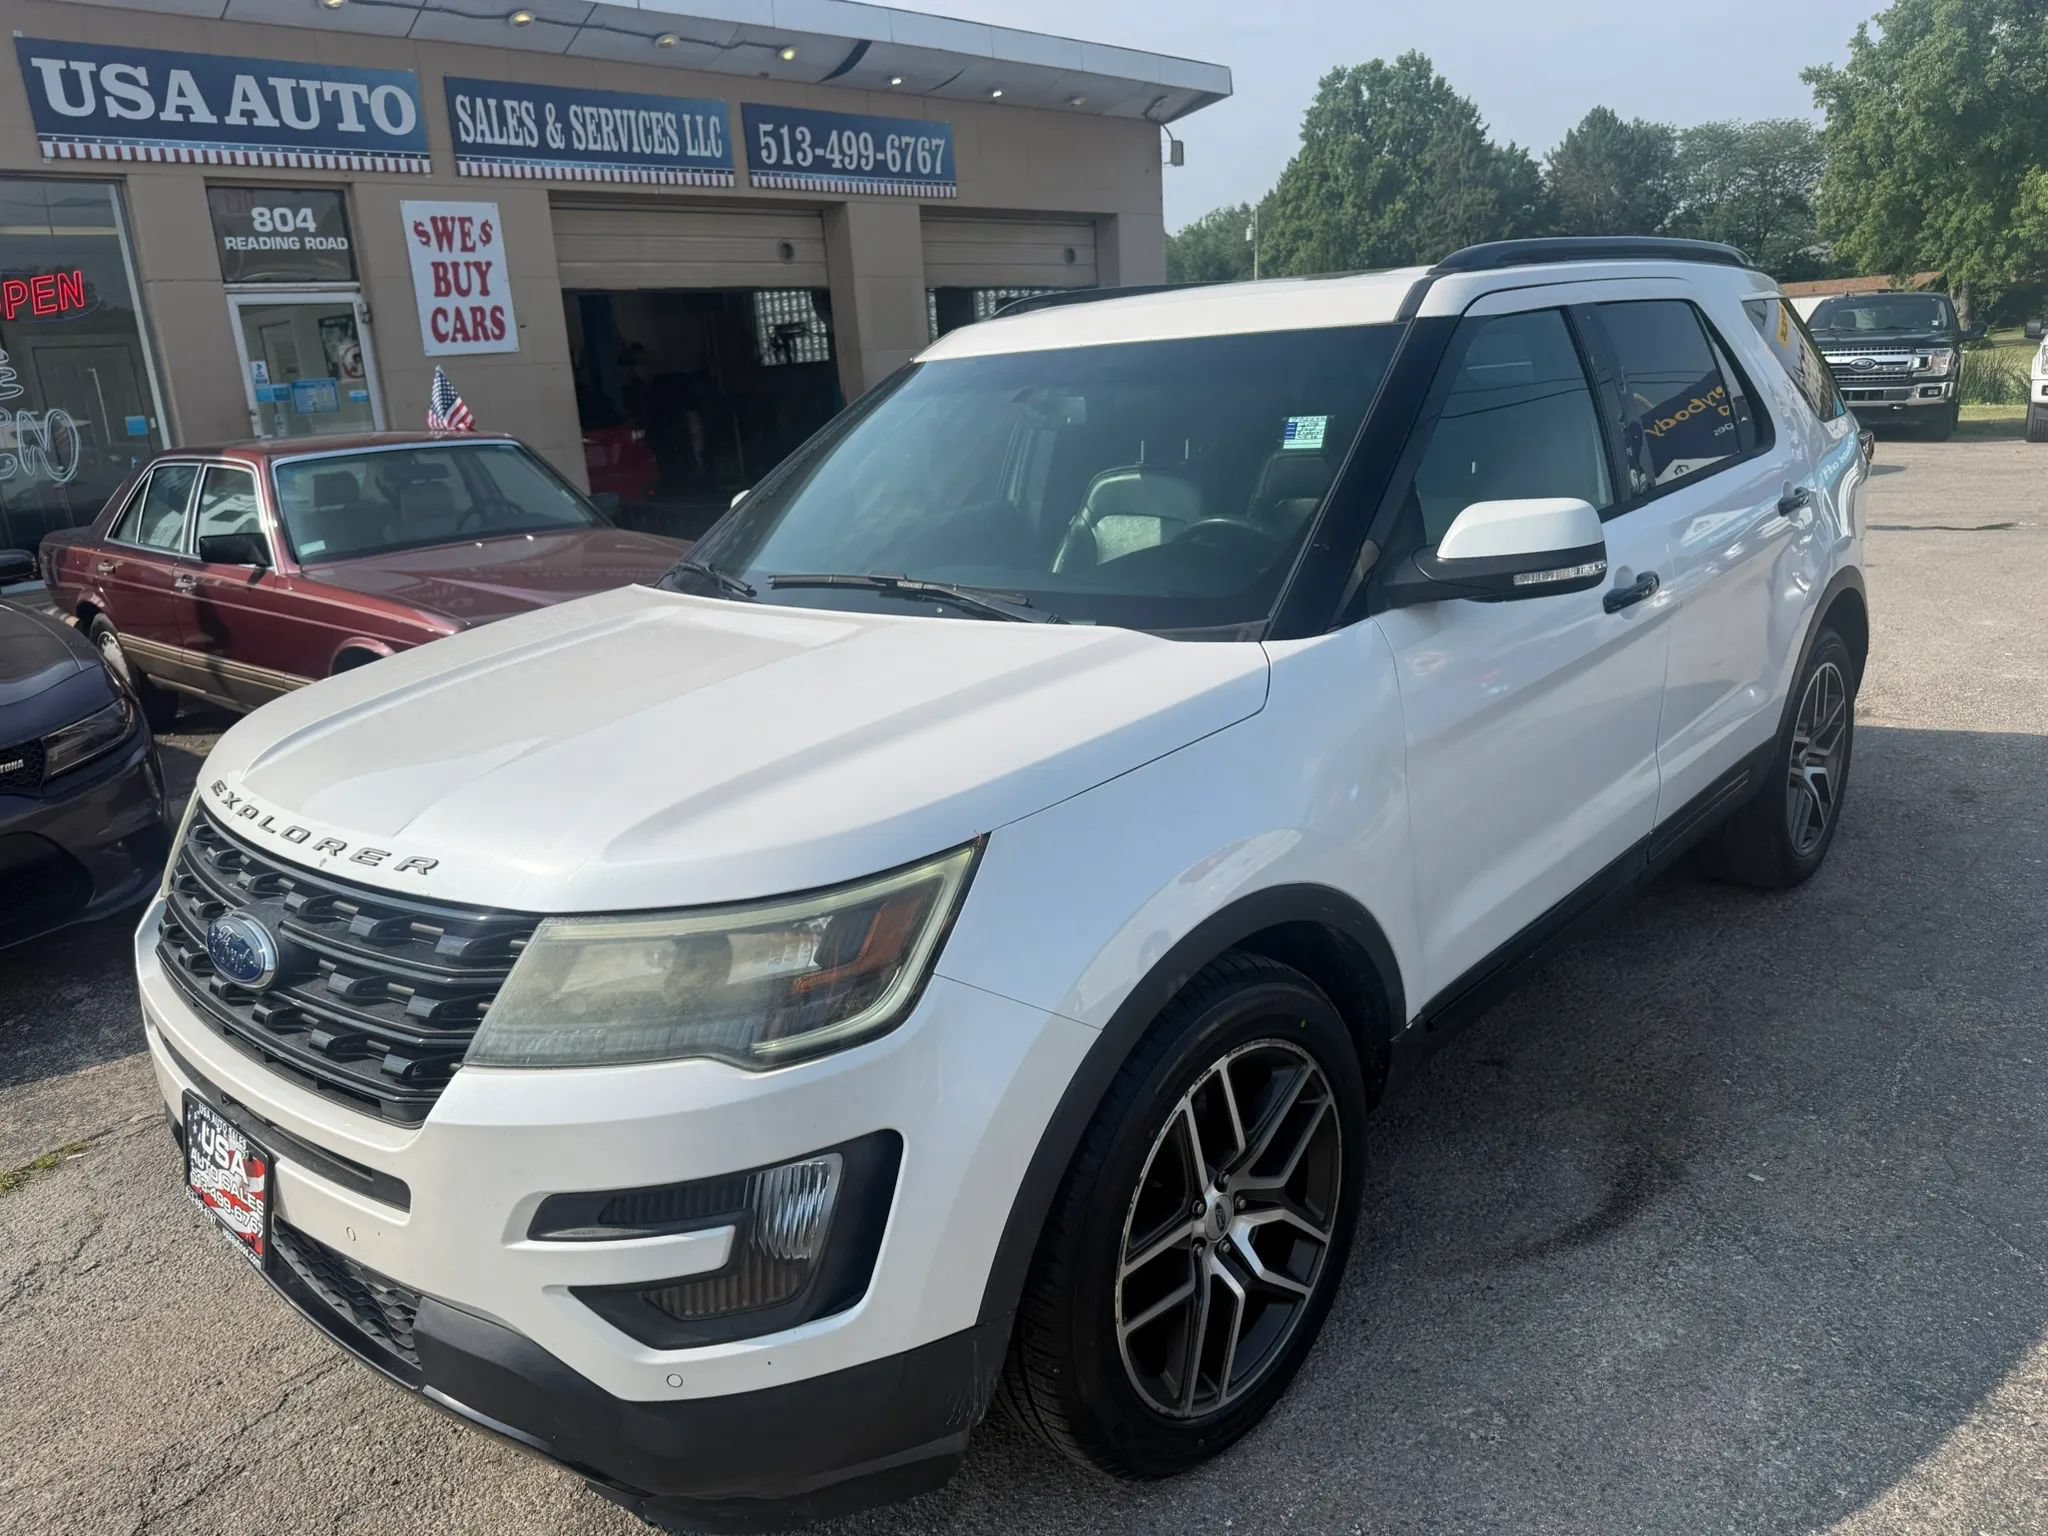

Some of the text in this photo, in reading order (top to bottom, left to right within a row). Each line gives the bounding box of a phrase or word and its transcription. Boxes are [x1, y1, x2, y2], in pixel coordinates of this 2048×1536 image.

[31, 57, 417, 136] USA AUTO
[455, 94, 723, 158] SALES & SERVICES LLC
[758, 122, 946, 175] 513-499-6767
[223, 236, 349, 250] READING ROAD
[251, 206, 317, 233] 804
[0, 270, 86, 321] PEN
[430, 260, 493, 298] BUY
[431, 305, 506, 343] CARS
[210, 779, 440, 876] EXPLORER
[201, 1120, 249, 1186] USA
[190, 1147, 220, 1184] AUTO
[219, 1173, 265, 1217] SALES
